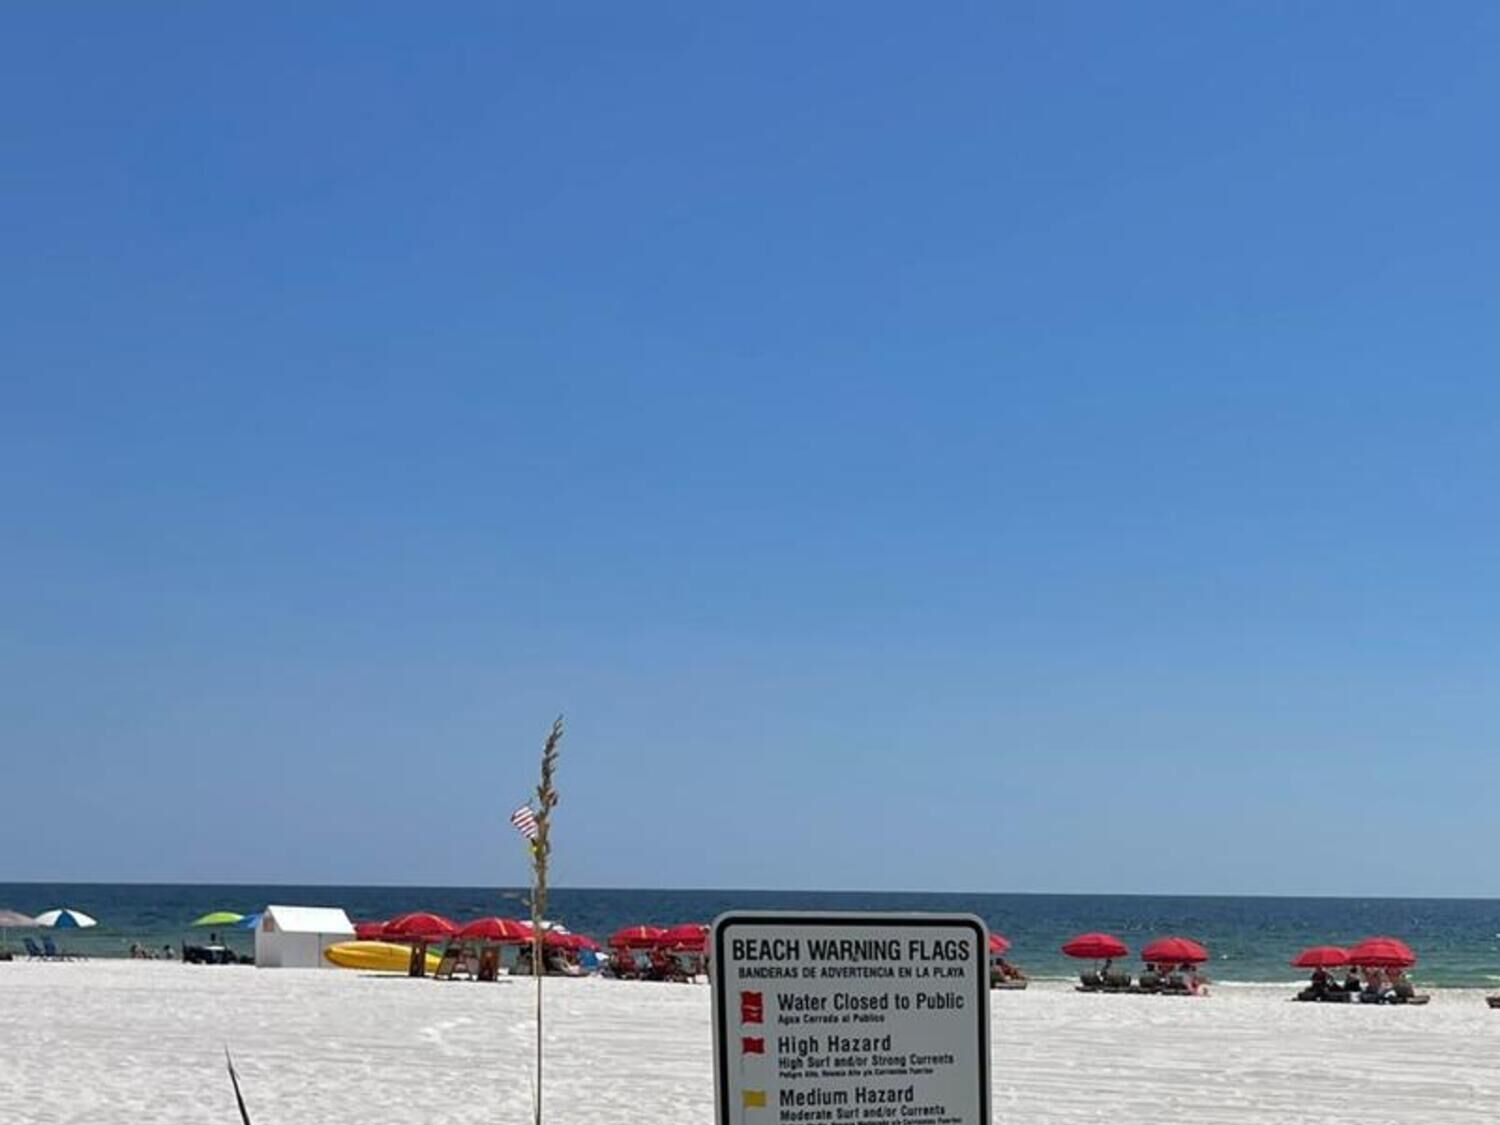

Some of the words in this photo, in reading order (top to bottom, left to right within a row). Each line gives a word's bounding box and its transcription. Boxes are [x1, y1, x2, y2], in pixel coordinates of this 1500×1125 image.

[732, 939, 799, 962] BEACH
[808, 939, 900, 962] WARNING
[908, 939, 970, 961] FLAGS
[738, 967, 798, 979] BANDERAS
[803, 967, 816, 978] DE
[820, 967, 895, 978] ADVERTENCIA
[900, 967, 912, 978] EN
[916, 967, 929, 978] LA
[933, 967, 965, 978] PLAYA
[778, 993, 826, 1011] Water
[834, 993, 888, 1010] Closed
[895, 994, 910, 1010] to
[916, 992, 964, 1009] Public
[778, 1014, 800, 1026] Agua
[842, 1014, 850, 1023] al
[778, 1036, 818, 1057] High
[828, 1034, 892, 1053] Hazard
[778, 1057, 803, 1070] High
[808, 1056, 830, 1068] Surf
[834, 1055, 868, 1067] and/or
[872, 1054, 906, 1068] Strong
[910, 1053, 955, 1066] Currents
[780, 1088, 848, 1107] Medium
[855, 1085, 914, 1104] Hazard
[780, 1108, 832, 1122] Moderate
[836, 1106, 860, 1119] Surf
[863, 1105, 897, 1118] and/or
[900, 1104, 946, 1116] Currents
